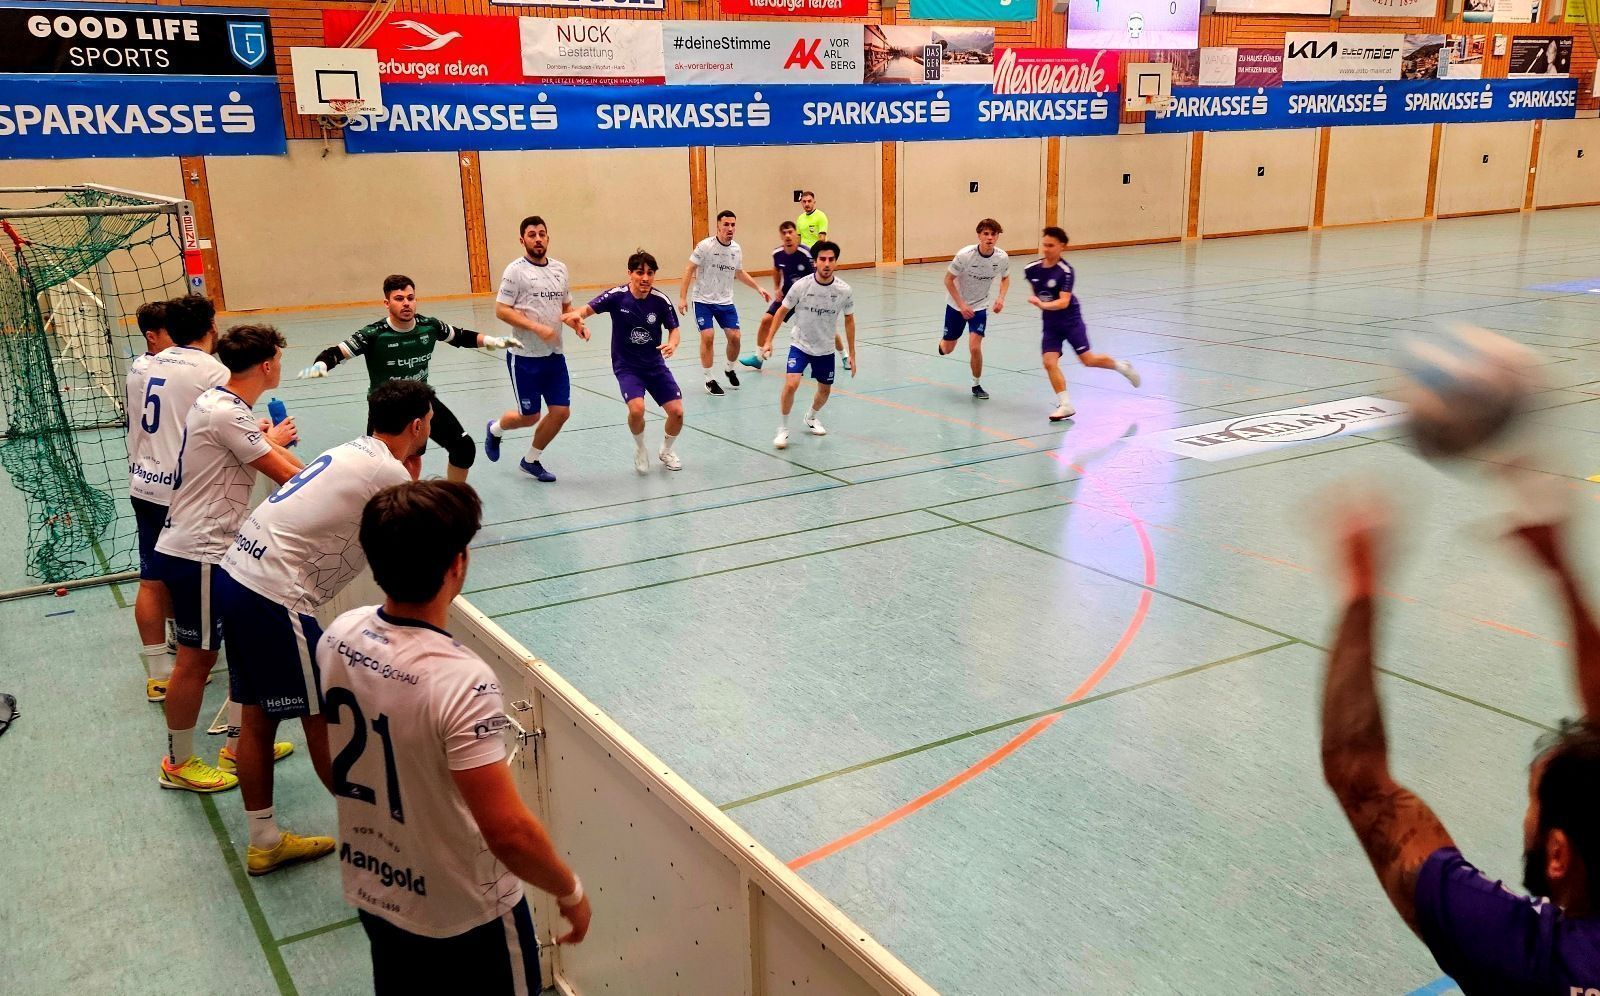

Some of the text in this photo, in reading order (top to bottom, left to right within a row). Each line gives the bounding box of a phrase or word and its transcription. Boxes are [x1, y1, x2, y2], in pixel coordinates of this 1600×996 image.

[1170, 1, 1177, 14] 0
[28, 15, 200, 41] GOOD LIFE
[557, 25, 612, 43] NUCK
[673, 35, 771, 50] #deineStimme
[829, 38, 850, 48] VOR
[926, 47, 940, 57] DAS
[1363, 45, 1400, 60] maier
[69, 46, 170, 68] SPORTS
[559, 46, 614, 60] Bestattung
[784, 38, 824, 70] AK
[823, 50, 842, 59] ARL
[379, 58, 489, 78] erburger reisen
[674, 62, 734, 72] ak-vorarlberg.at
[830, 61, 856, 70] BERG
[926, 59, 940, 68] GER
[993, 48, 1109, 95] Messepark
[926, 69, 939, 79] STL
[1288, 94, 1372, 114] SPARKASSE
[1404, 91, 1480, 112] SPARKASSE
[1508, 90, 1576, 108] SPARKASSE
[0, 104, 216, 136] SPARKASSE
[350, 104, 526, 132] SPARKASSE
[596, 103, 744, 129] SPARKASSE
[803, 100, 928, 126] SPARKASSE
[978, 99, 1089, 122] SPARKASSE
[183, 216, 197, 248] BENZ
[141, 376, 167, 434] 5
[269, 454, 333, 504] 9
[266, 696, 305, 708] Helbok
[325, 687, 405, 825] 21
[340, 842, 426, 896] Mangold
